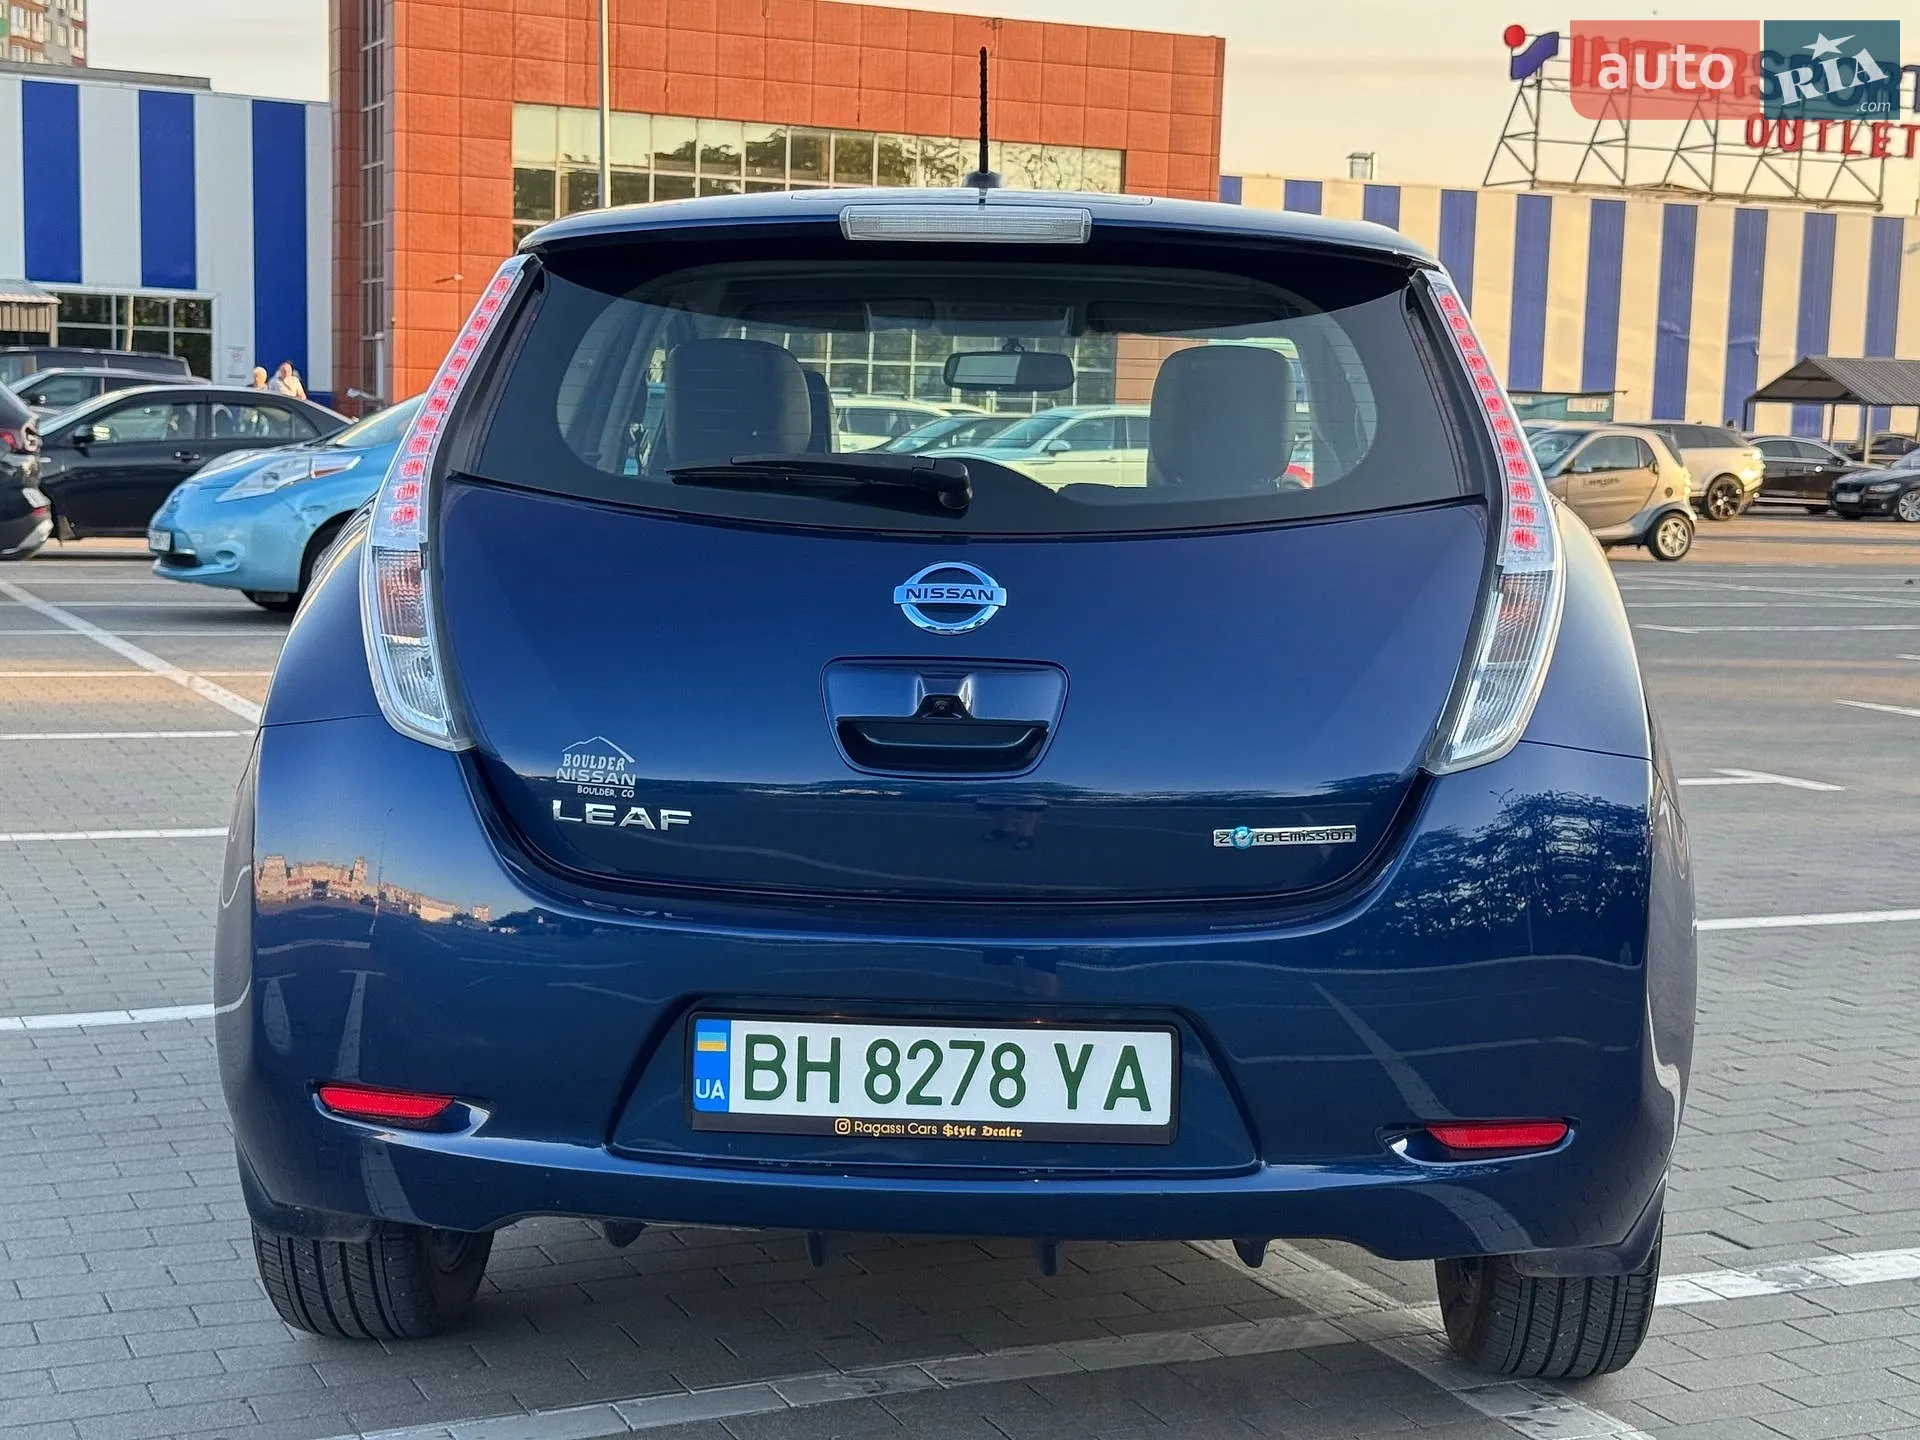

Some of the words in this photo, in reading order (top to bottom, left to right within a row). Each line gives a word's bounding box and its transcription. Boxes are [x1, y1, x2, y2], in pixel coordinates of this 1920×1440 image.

[1746, 113, 1920, 159] OUTLET
[905, 588, 994, 601] NISSAN
[562, 753, 625, 771] BOULDER
[556, 768, 636, 786] NISSAN
[621, 789, 635, 798] CO
[552, 800, 692, 831] LEAF
[1279, 830, 1353, 842] Emission
[744, 1033, 841, 1104] BH
[864, 1038, 1026, 1108] 8278
[1054, 1043, 1152, 1112] YA
[695, 1078, 726, 1100] UA
[907, 1122, 938, 1135] Cars
[982, 1125, 1023, 1138] Dealer
